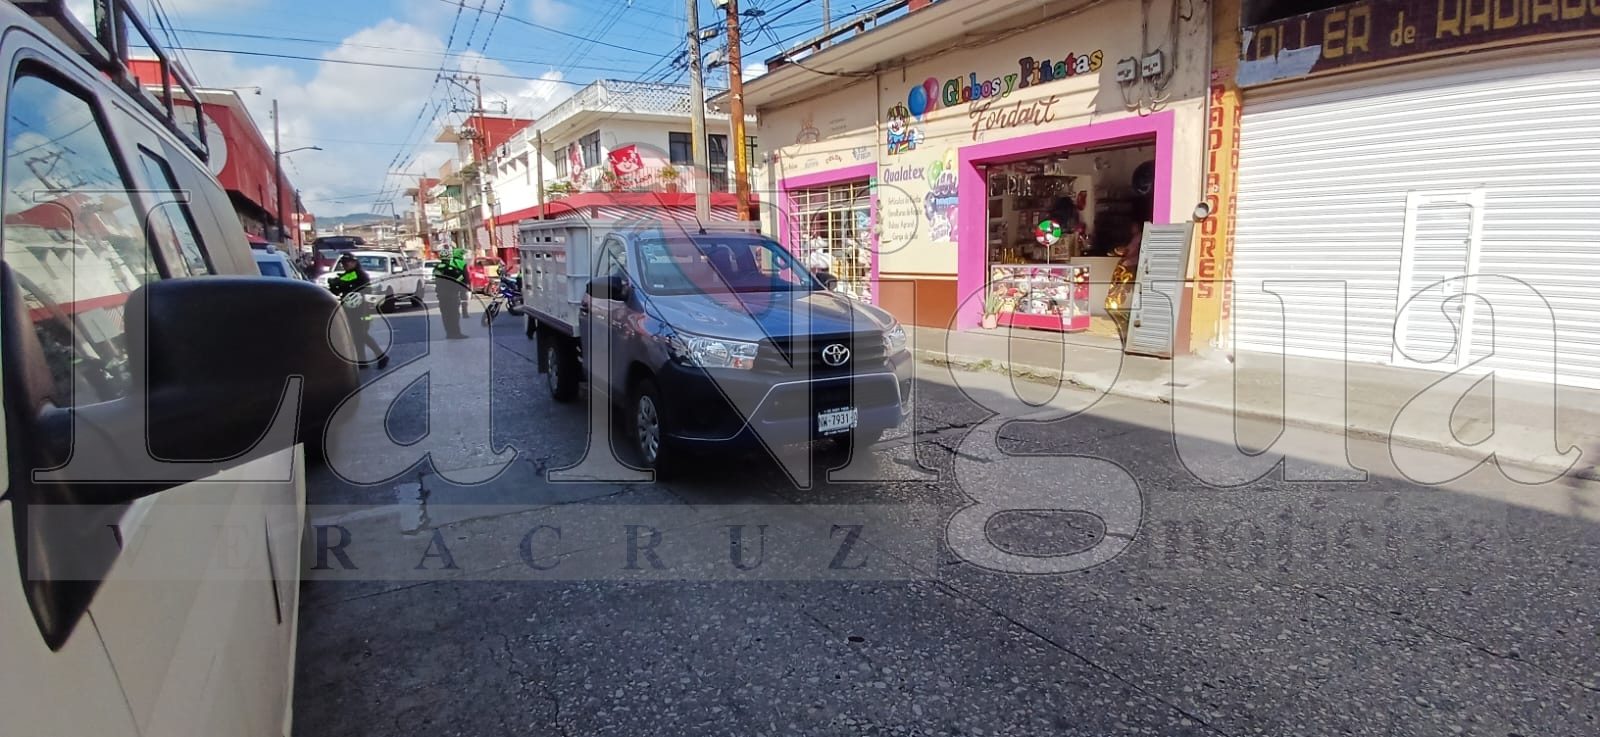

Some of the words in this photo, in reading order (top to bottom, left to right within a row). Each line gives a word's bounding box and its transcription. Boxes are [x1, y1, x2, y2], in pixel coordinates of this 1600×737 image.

[1391, 12, 1415, 47] de
[943, 72, 1001, 107] Globos
[1002, 73, 1018, 97] y
[1018, 50, 1103, 88] Piñatas
[883, 164, 925, 184] Qualatex
[1197, 84, 1226, 299] RADIADORES
